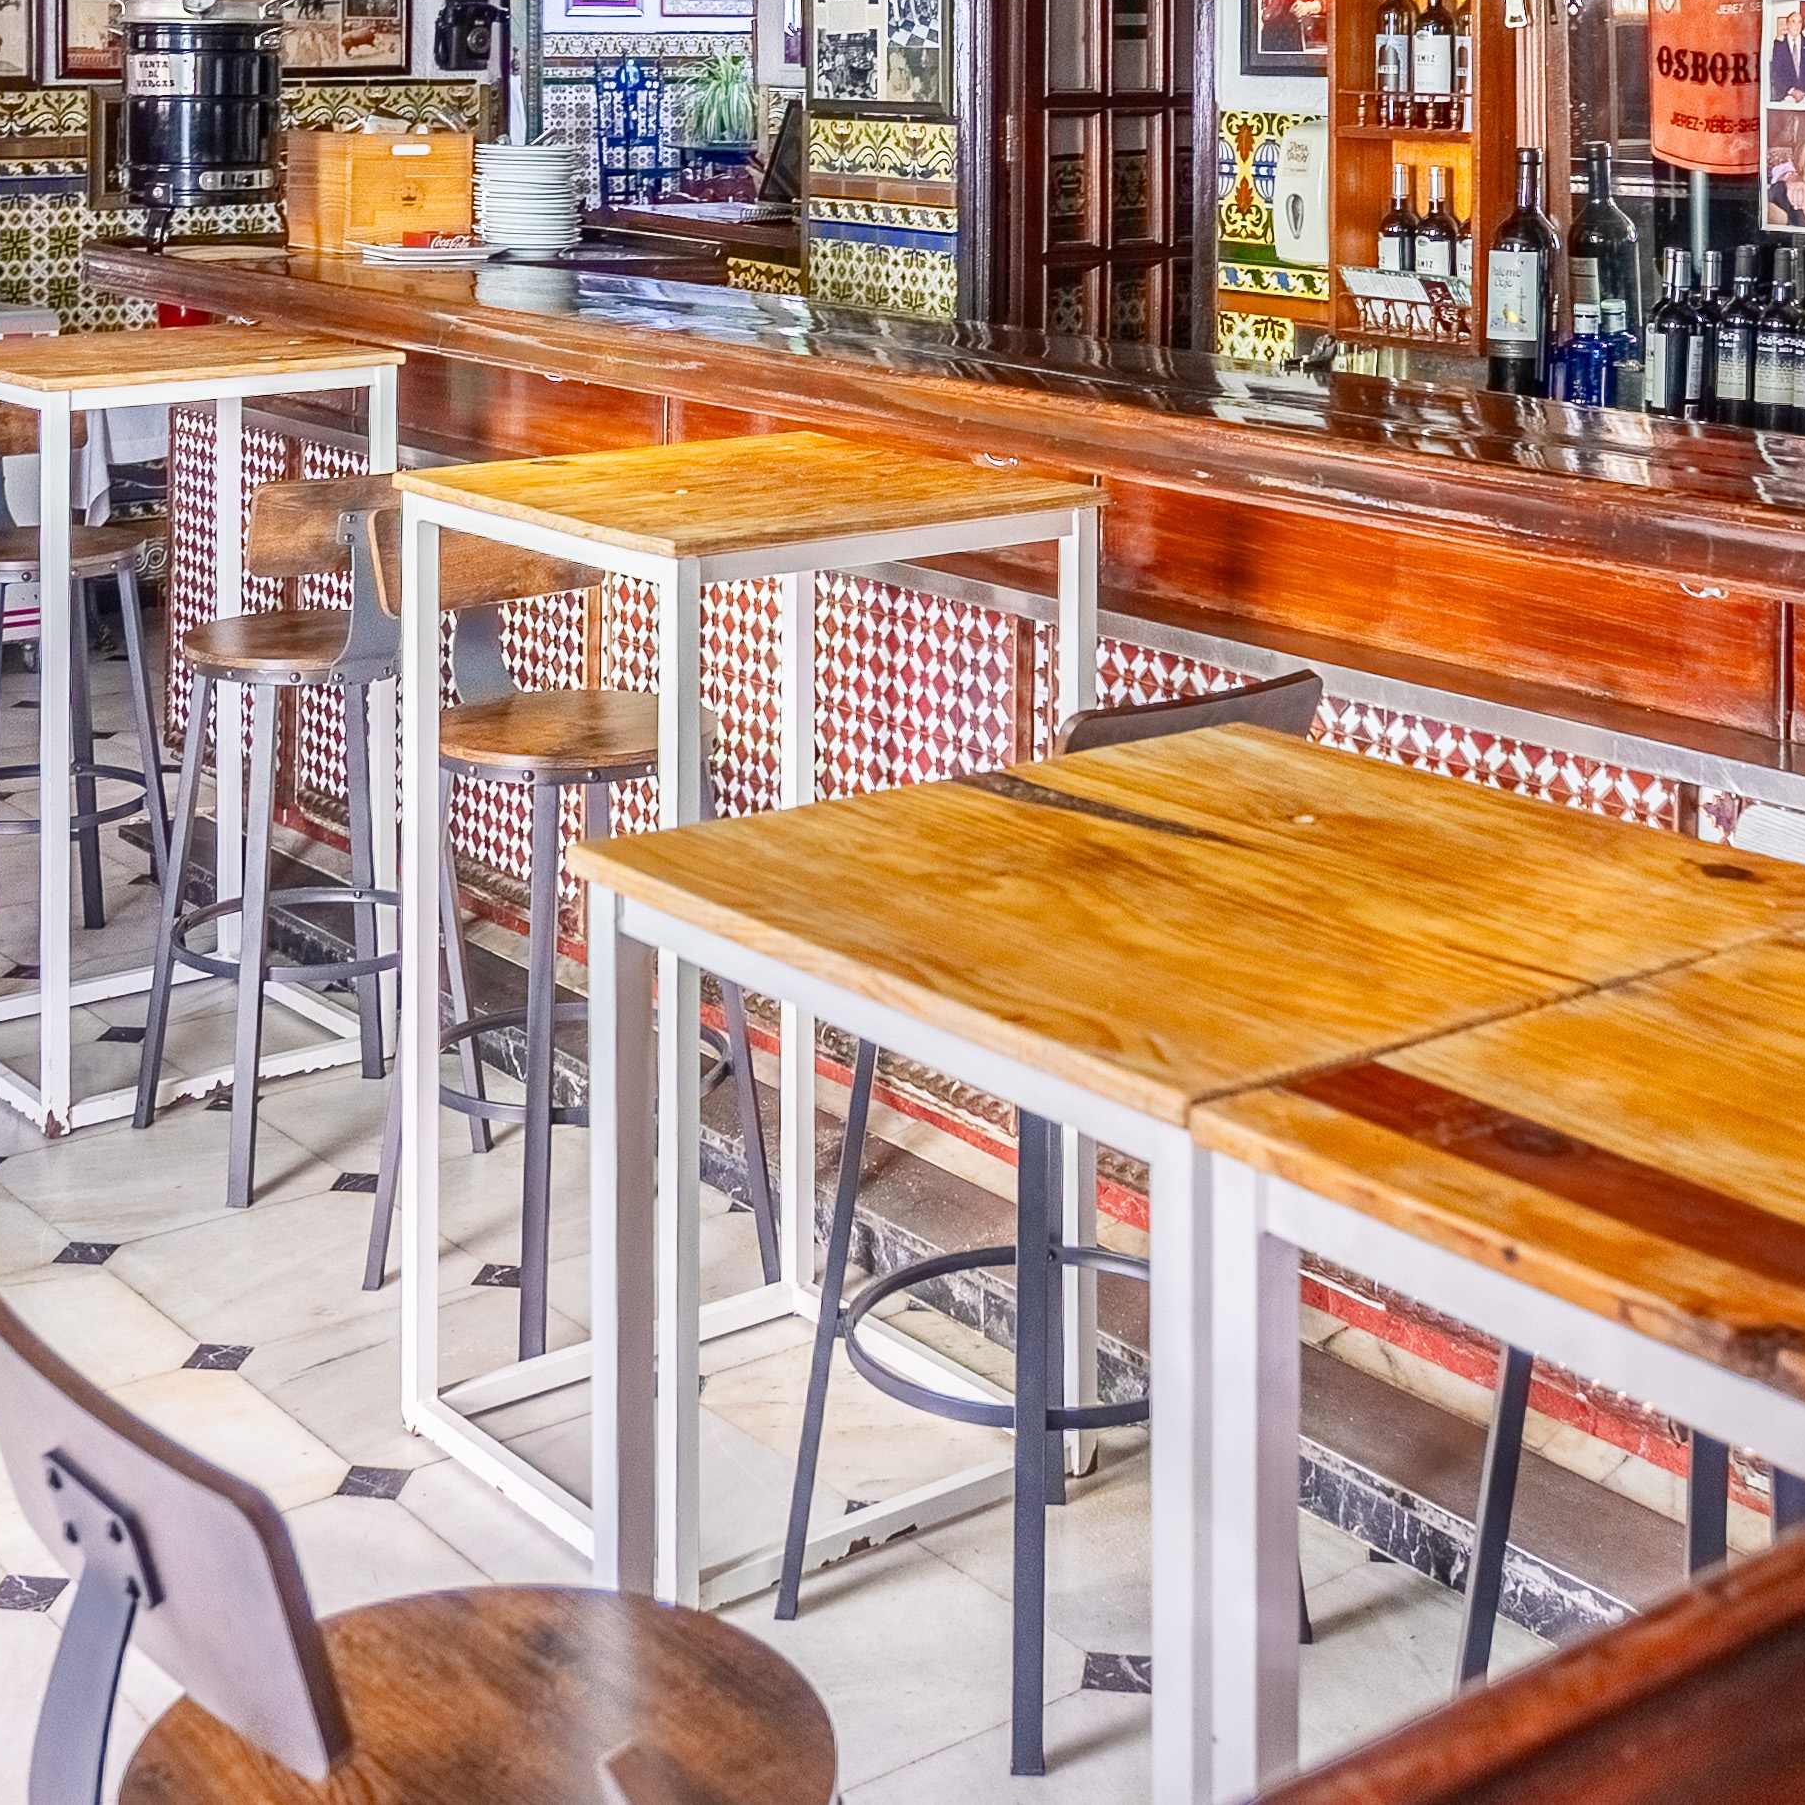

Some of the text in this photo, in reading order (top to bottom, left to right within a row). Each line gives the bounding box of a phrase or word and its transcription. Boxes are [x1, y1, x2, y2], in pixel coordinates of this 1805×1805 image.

[1715, 1, 1763, 15] JEREZ SE
[138, 60, 169, 69] VENTA
[148, 70, 159, 78] DE
[136, 79, 176, 88] VARGAS
